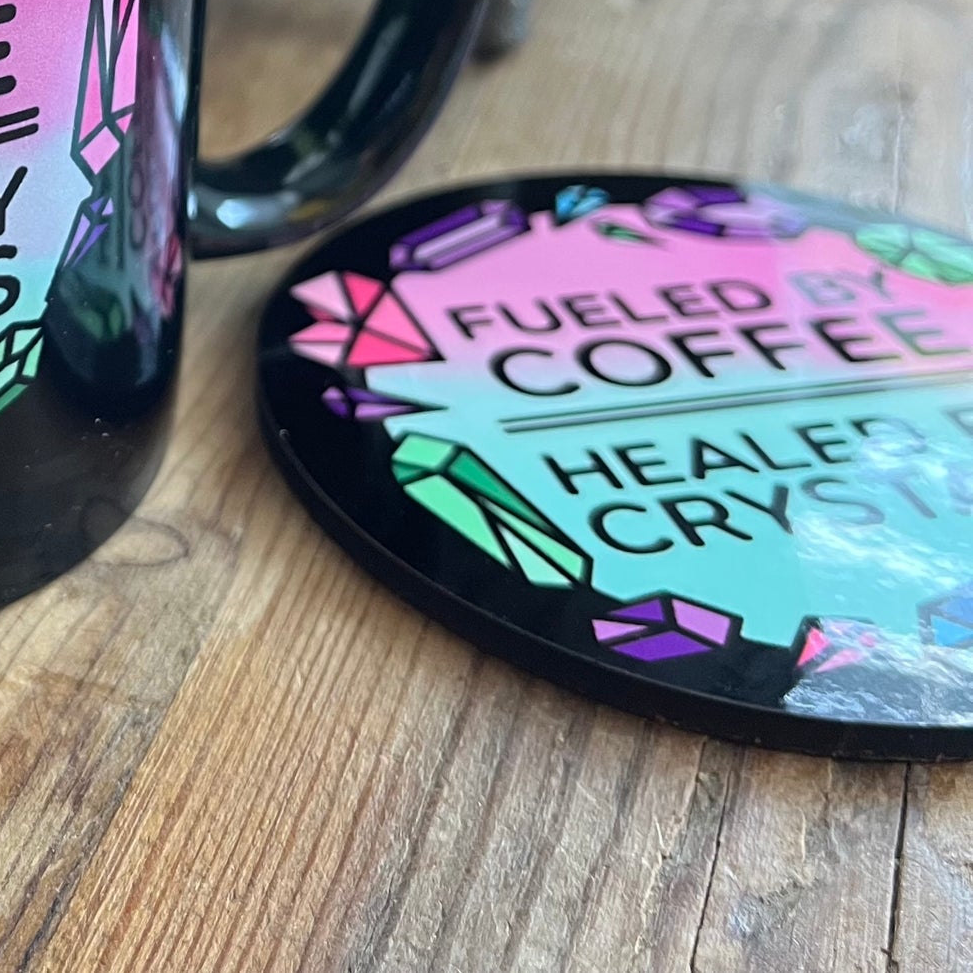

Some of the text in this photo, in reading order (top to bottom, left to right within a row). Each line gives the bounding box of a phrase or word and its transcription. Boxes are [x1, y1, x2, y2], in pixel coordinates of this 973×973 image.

[446, 262, 891, 341] FUELED BY
[489, 313, 971, 397] COFFEE
